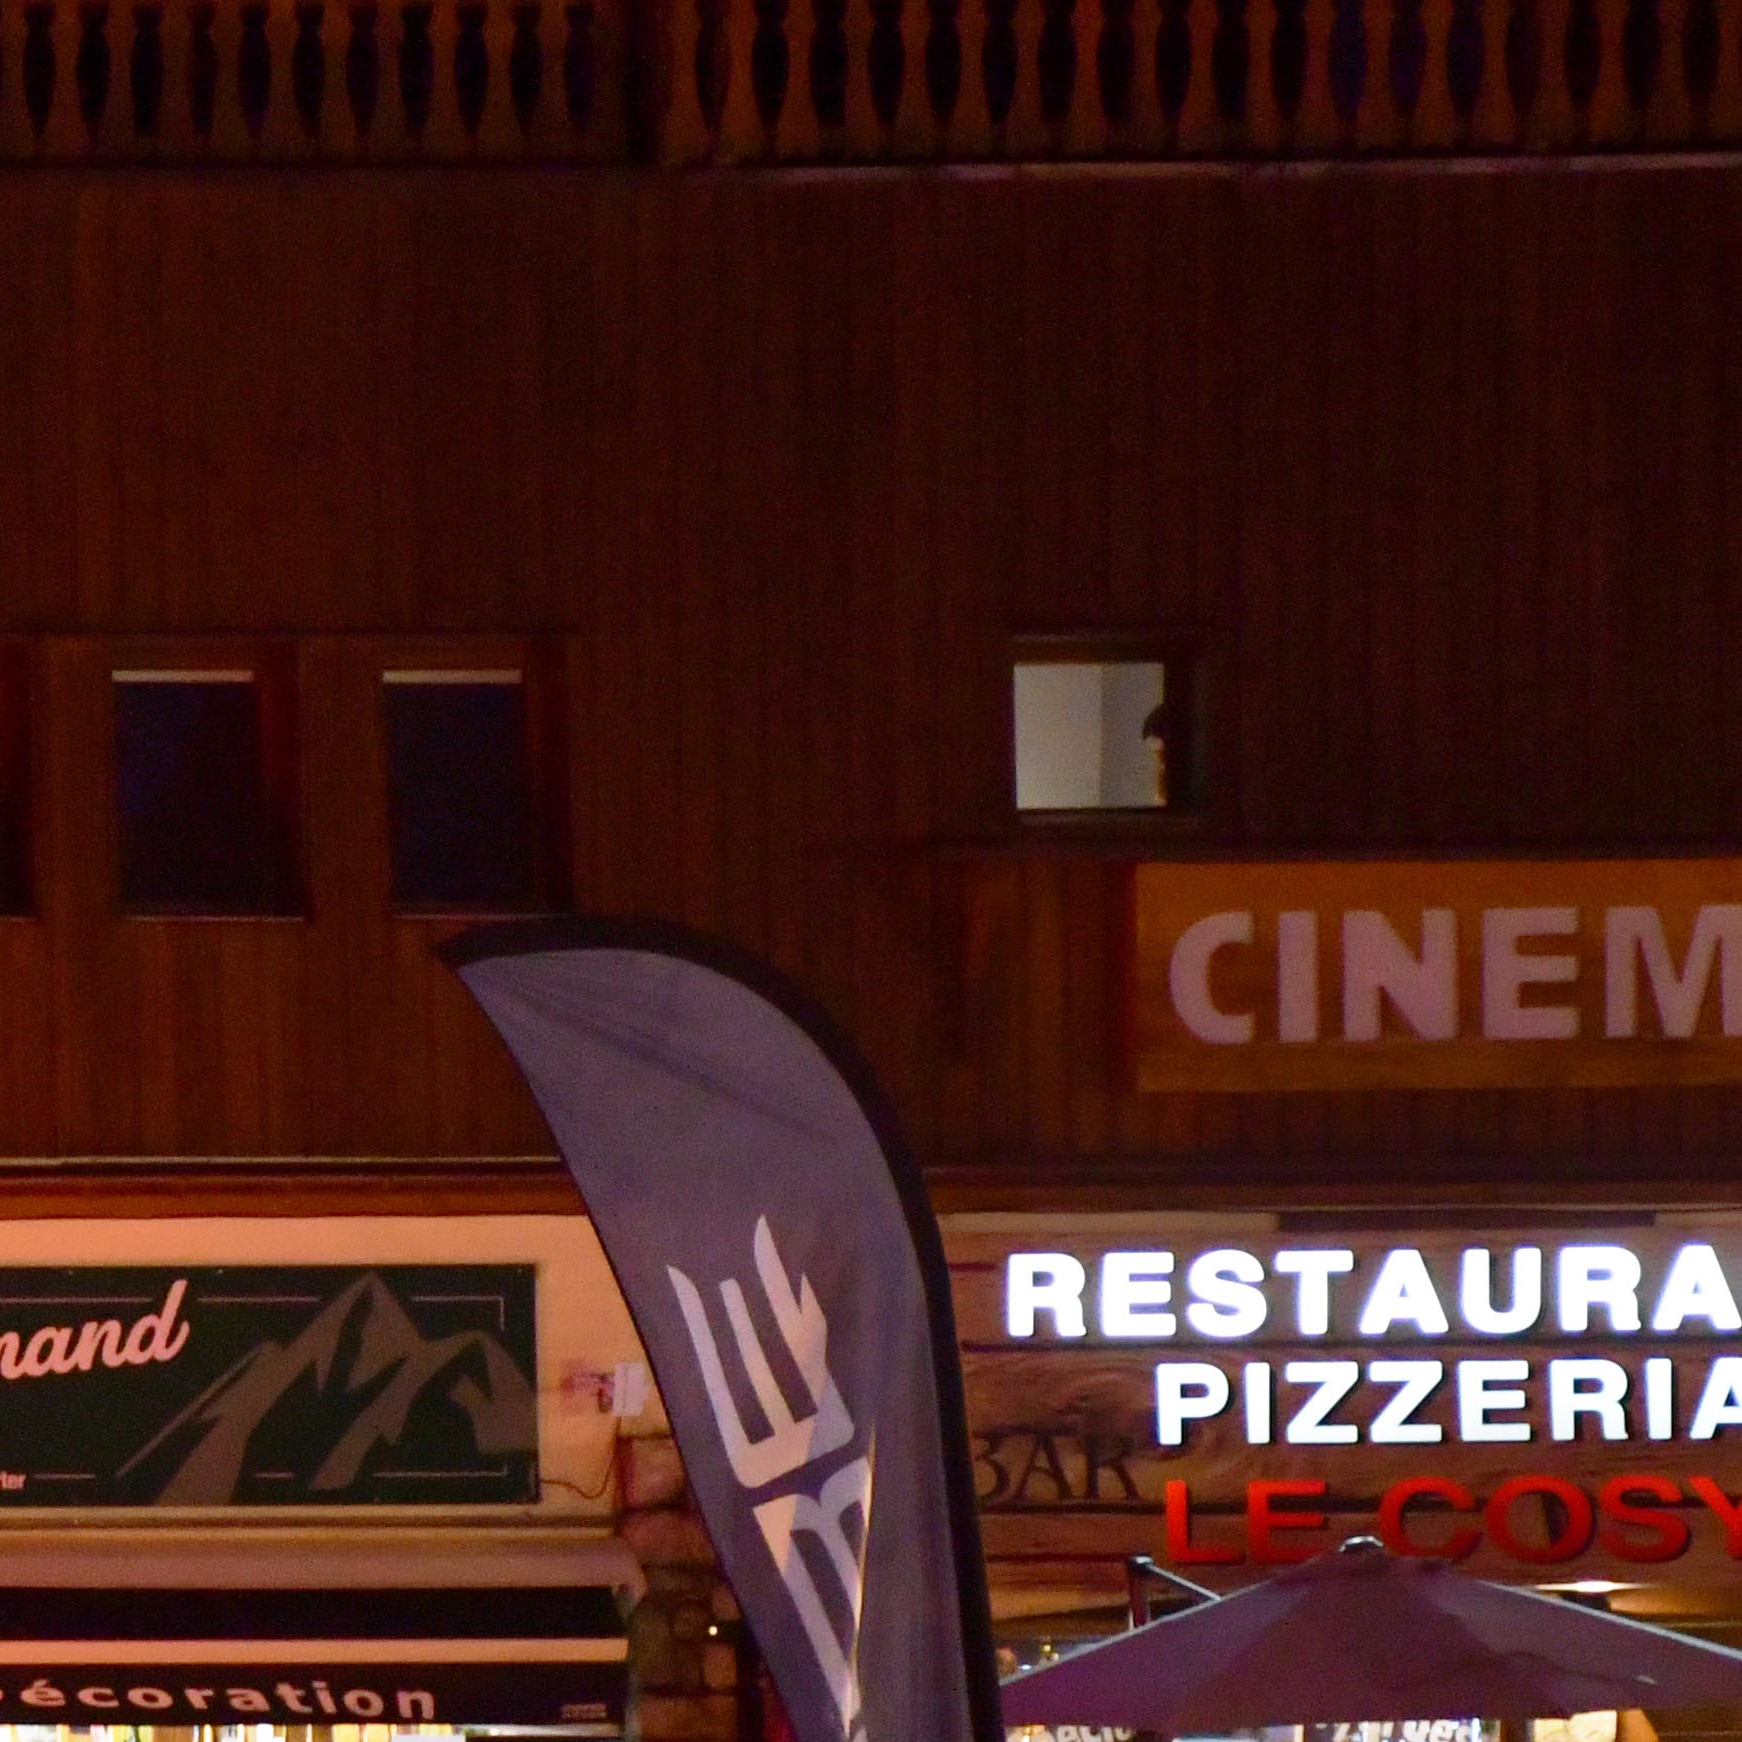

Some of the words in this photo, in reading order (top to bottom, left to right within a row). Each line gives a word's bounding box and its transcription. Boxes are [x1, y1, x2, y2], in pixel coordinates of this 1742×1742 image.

[1170, 904, 1742, 1046] CINEM
[1004, 1244, 1742, 1339] RESTAURA
[1165, 1479, 1327, 1565] LE
